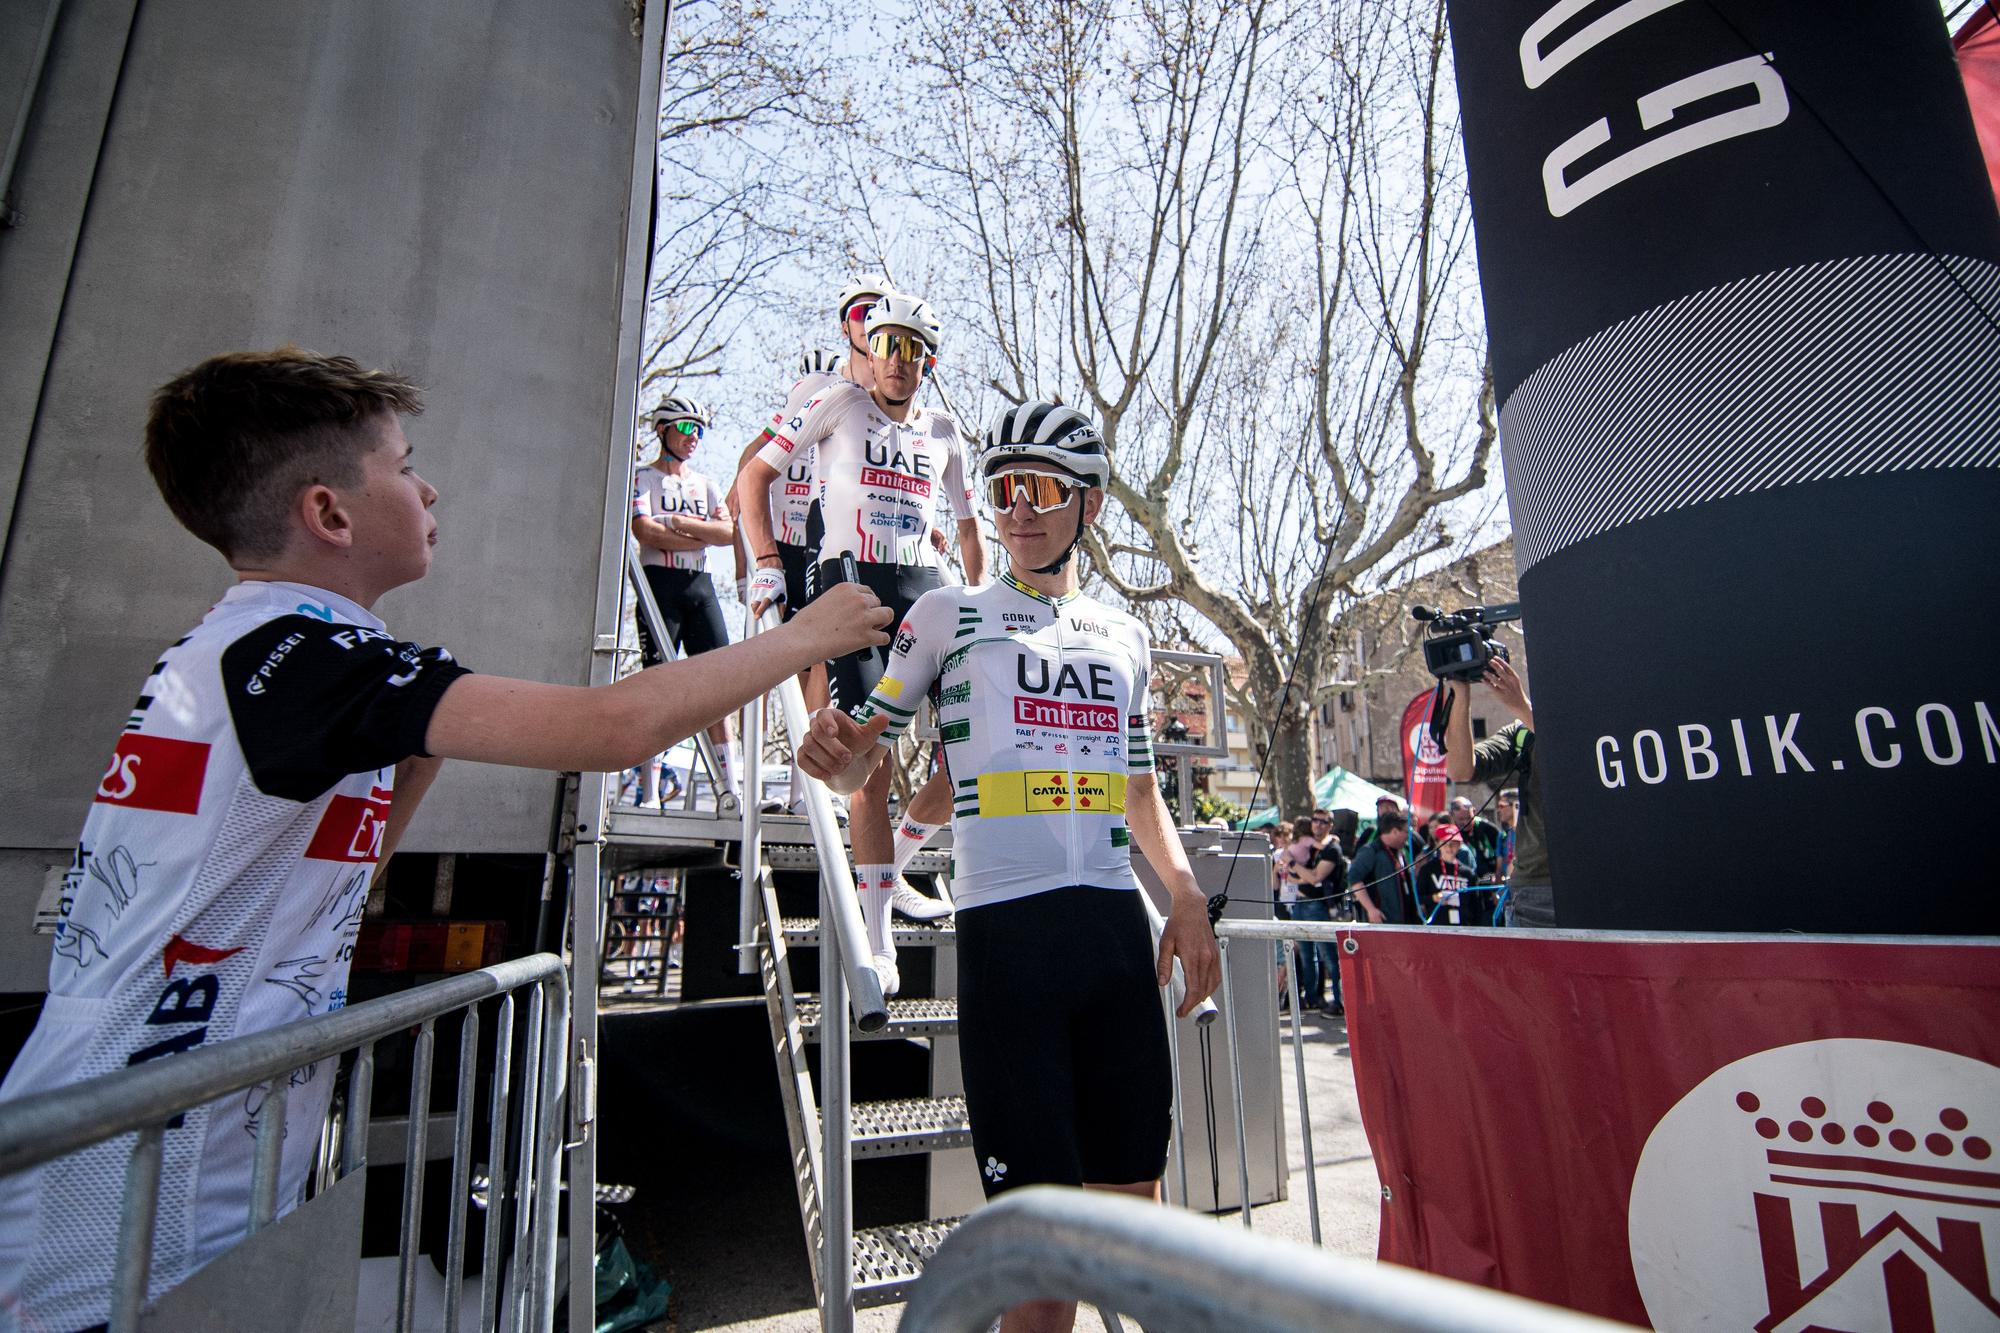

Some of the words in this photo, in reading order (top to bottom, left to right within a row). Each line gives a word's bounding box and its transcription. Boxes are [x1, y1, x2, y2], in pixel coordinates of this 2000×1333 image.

[1067, 429, 1095, 443] ME
[865, 440, 930, 479] UAE
[1000, 446, 1029, 454] MET
[863, 468, 930, 496] Emirates
[661, 495, 708, 517] UAE
[805, 560, 817, 599] UAE
[1002, 613, 1036, 623] GOBIK
[1070, 618, 1109, 637] Volta
[260, 632, 306, 678] PISSEI
[1017, 653, 1116, 702] UAE
[1018, 699, 1117, 729] Emirates
[1016, 728, 1031, 737] FAB
[1032, 786, 1105, 796] CATALUNYA
